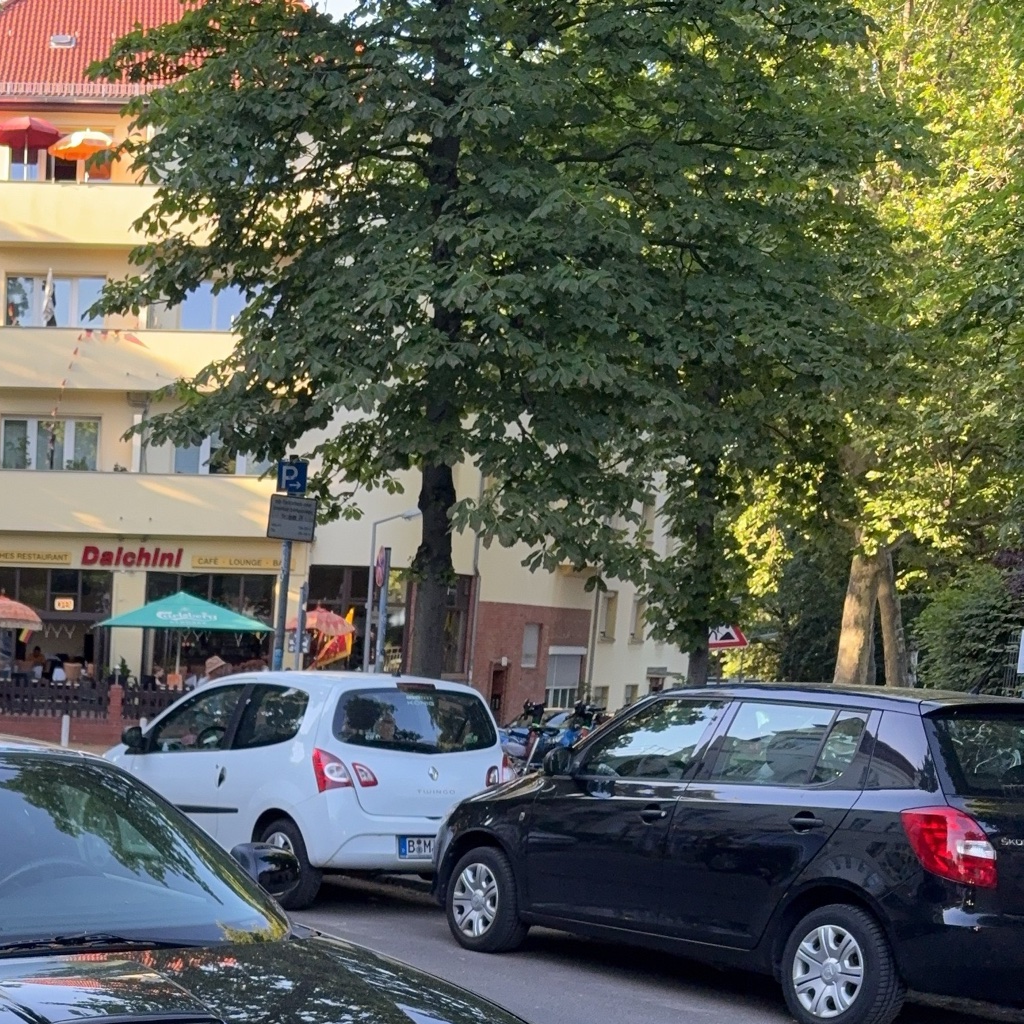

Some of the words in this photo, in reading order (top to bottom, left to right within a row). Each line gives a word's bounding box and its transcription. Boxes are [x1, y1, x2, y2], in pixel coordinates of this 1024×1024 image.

[280, 465, 299, 489] P
[17, 552, 69, 562] RESTAURANT
[228, 558, 262, 567] LOUNGE
[272, 559, 282, 567] BA
[155, 610, 218, 622] Carlsberg
[407, 840, 416, 853] B
[423, 840, 434, 853] M
[1000, 837, 1024, 846] ŠKO
